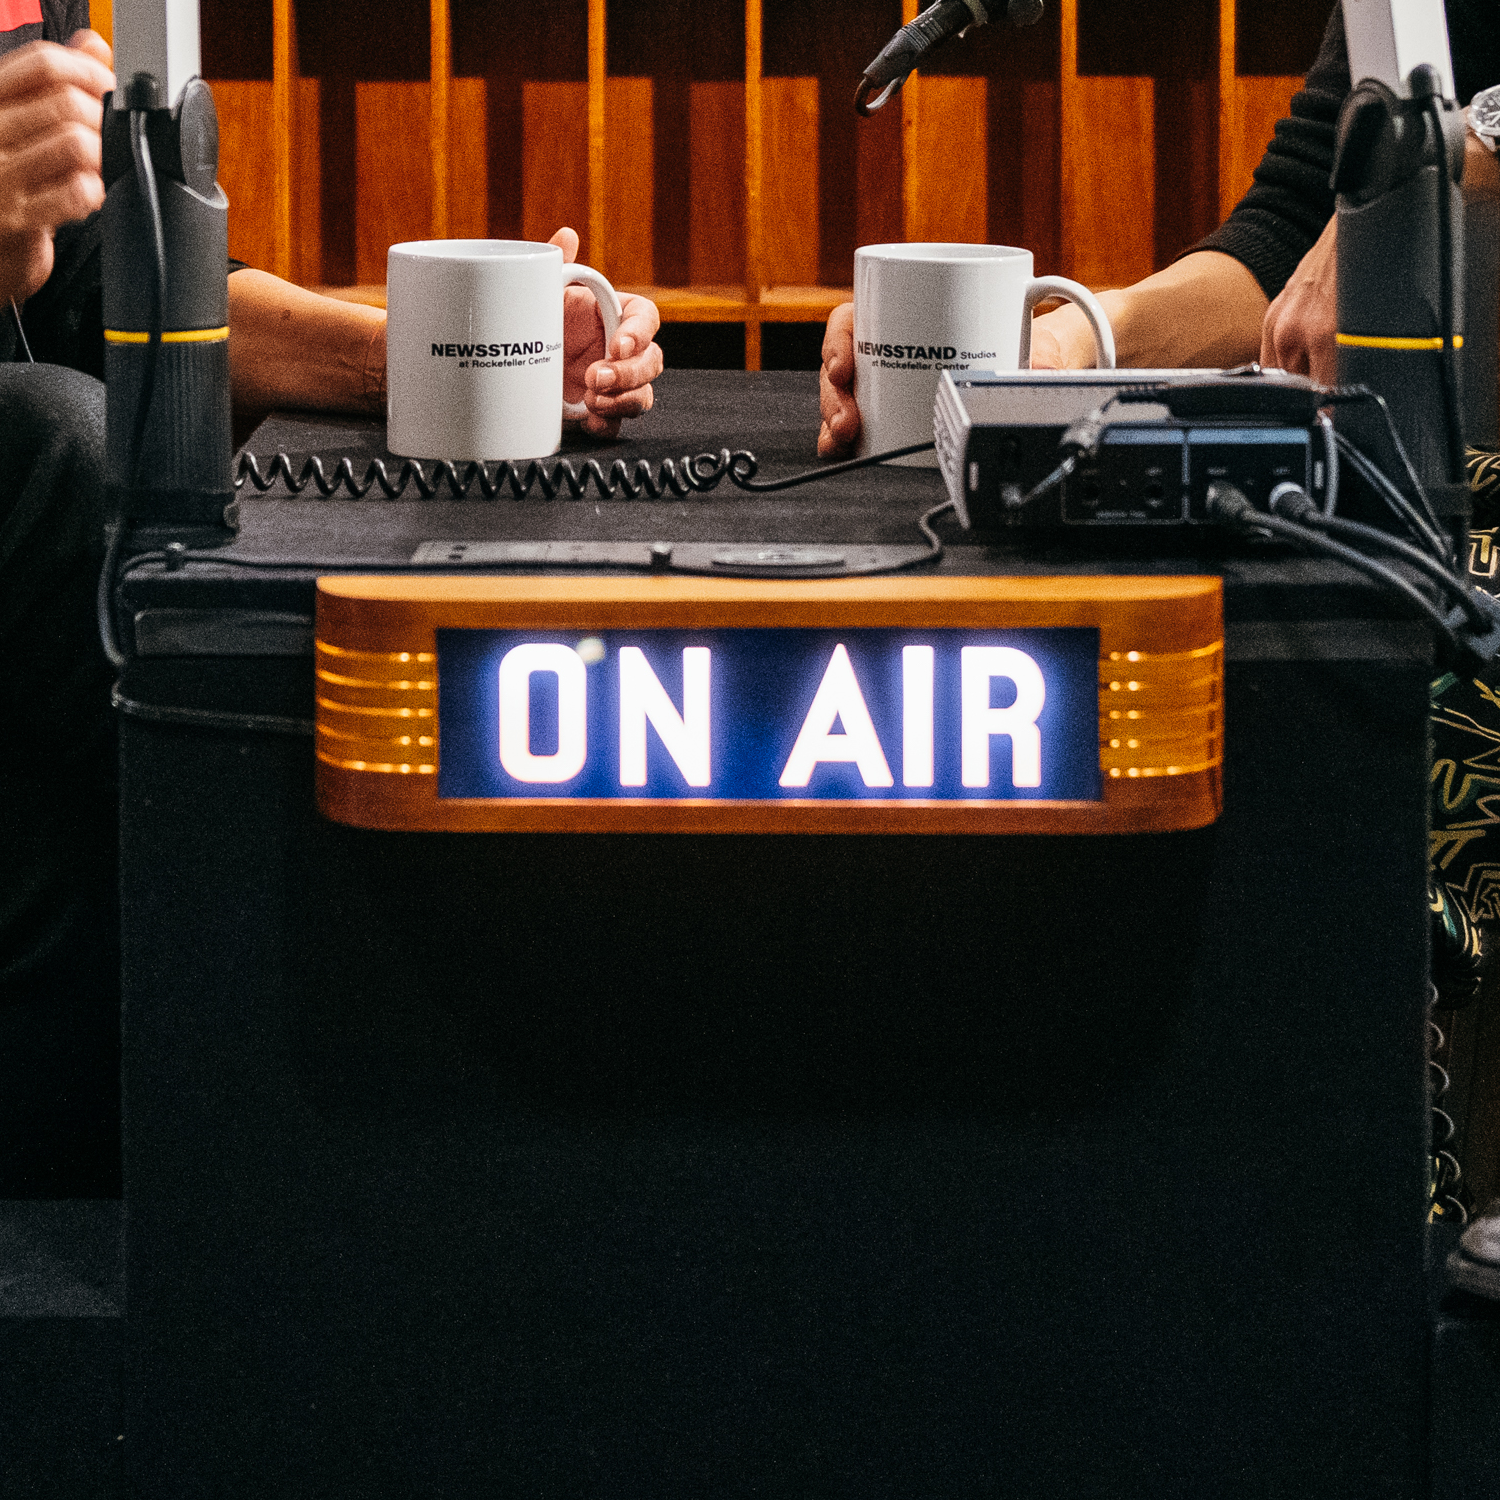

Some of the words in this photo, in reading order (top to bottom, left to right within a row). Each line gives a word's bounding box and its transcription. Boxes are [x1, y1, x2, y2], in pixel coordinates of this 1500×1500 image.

[431, 341, 544, 357] NEWSSTAND
[858, 341, 957, 360] NEWSSTAND
[960, 351, 997, 359] Studios
[472, 359, 526, 368] Rockefeller
[528, 356, 552, 365] Center
[880, 360, 933, 370] Rockefeller
[935, 362, 970, 371] Center
[499, 643, 711, 787] ON
[779, 643, 1046, 787] AIR
